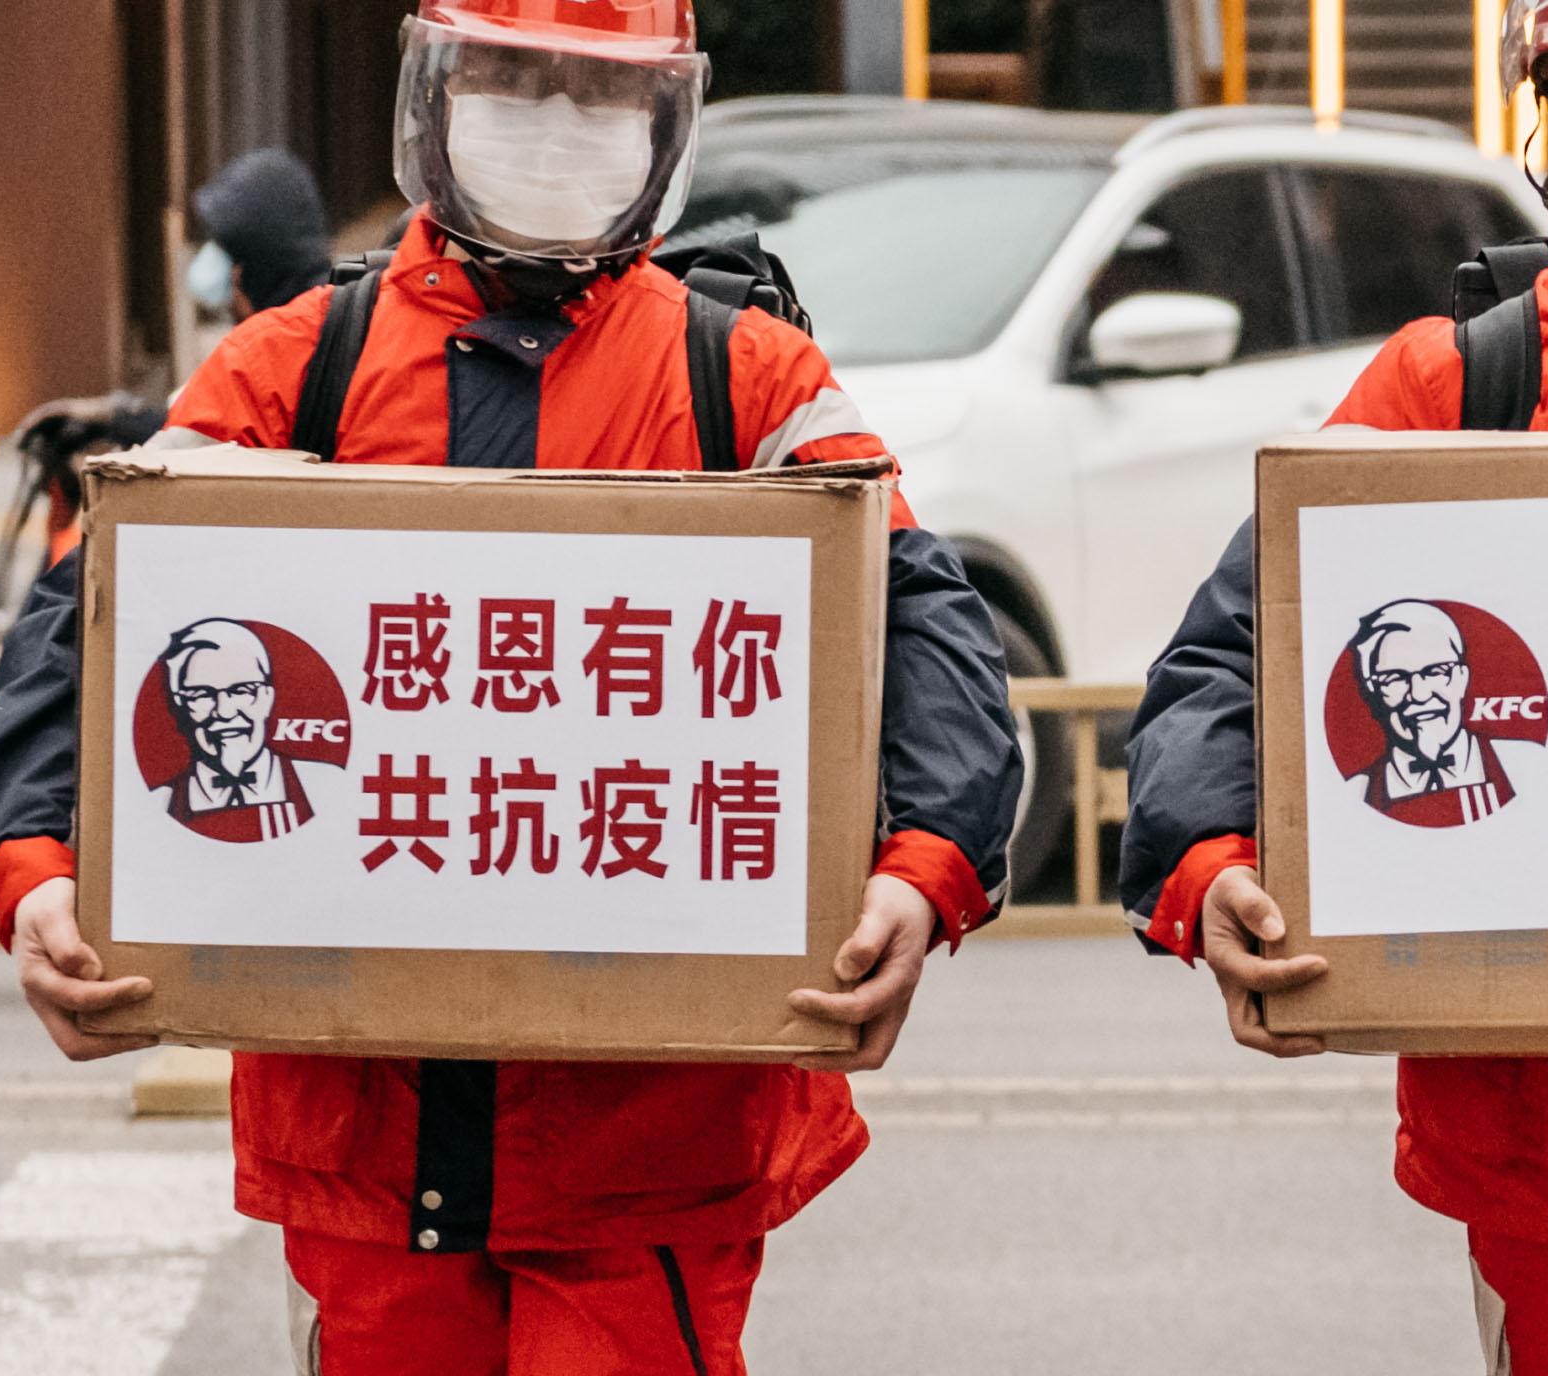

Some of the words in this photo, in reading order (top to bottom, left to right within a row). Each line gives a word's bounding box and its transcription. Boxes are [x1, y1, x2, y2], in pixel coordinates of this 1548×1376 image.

[361, 591, 783, 718] 感恩有你
[272, 717, 347, 742] KFC
[1470, 694, 1546, 721] KFC
[358, 753, 781, 881] 共抗疫情
